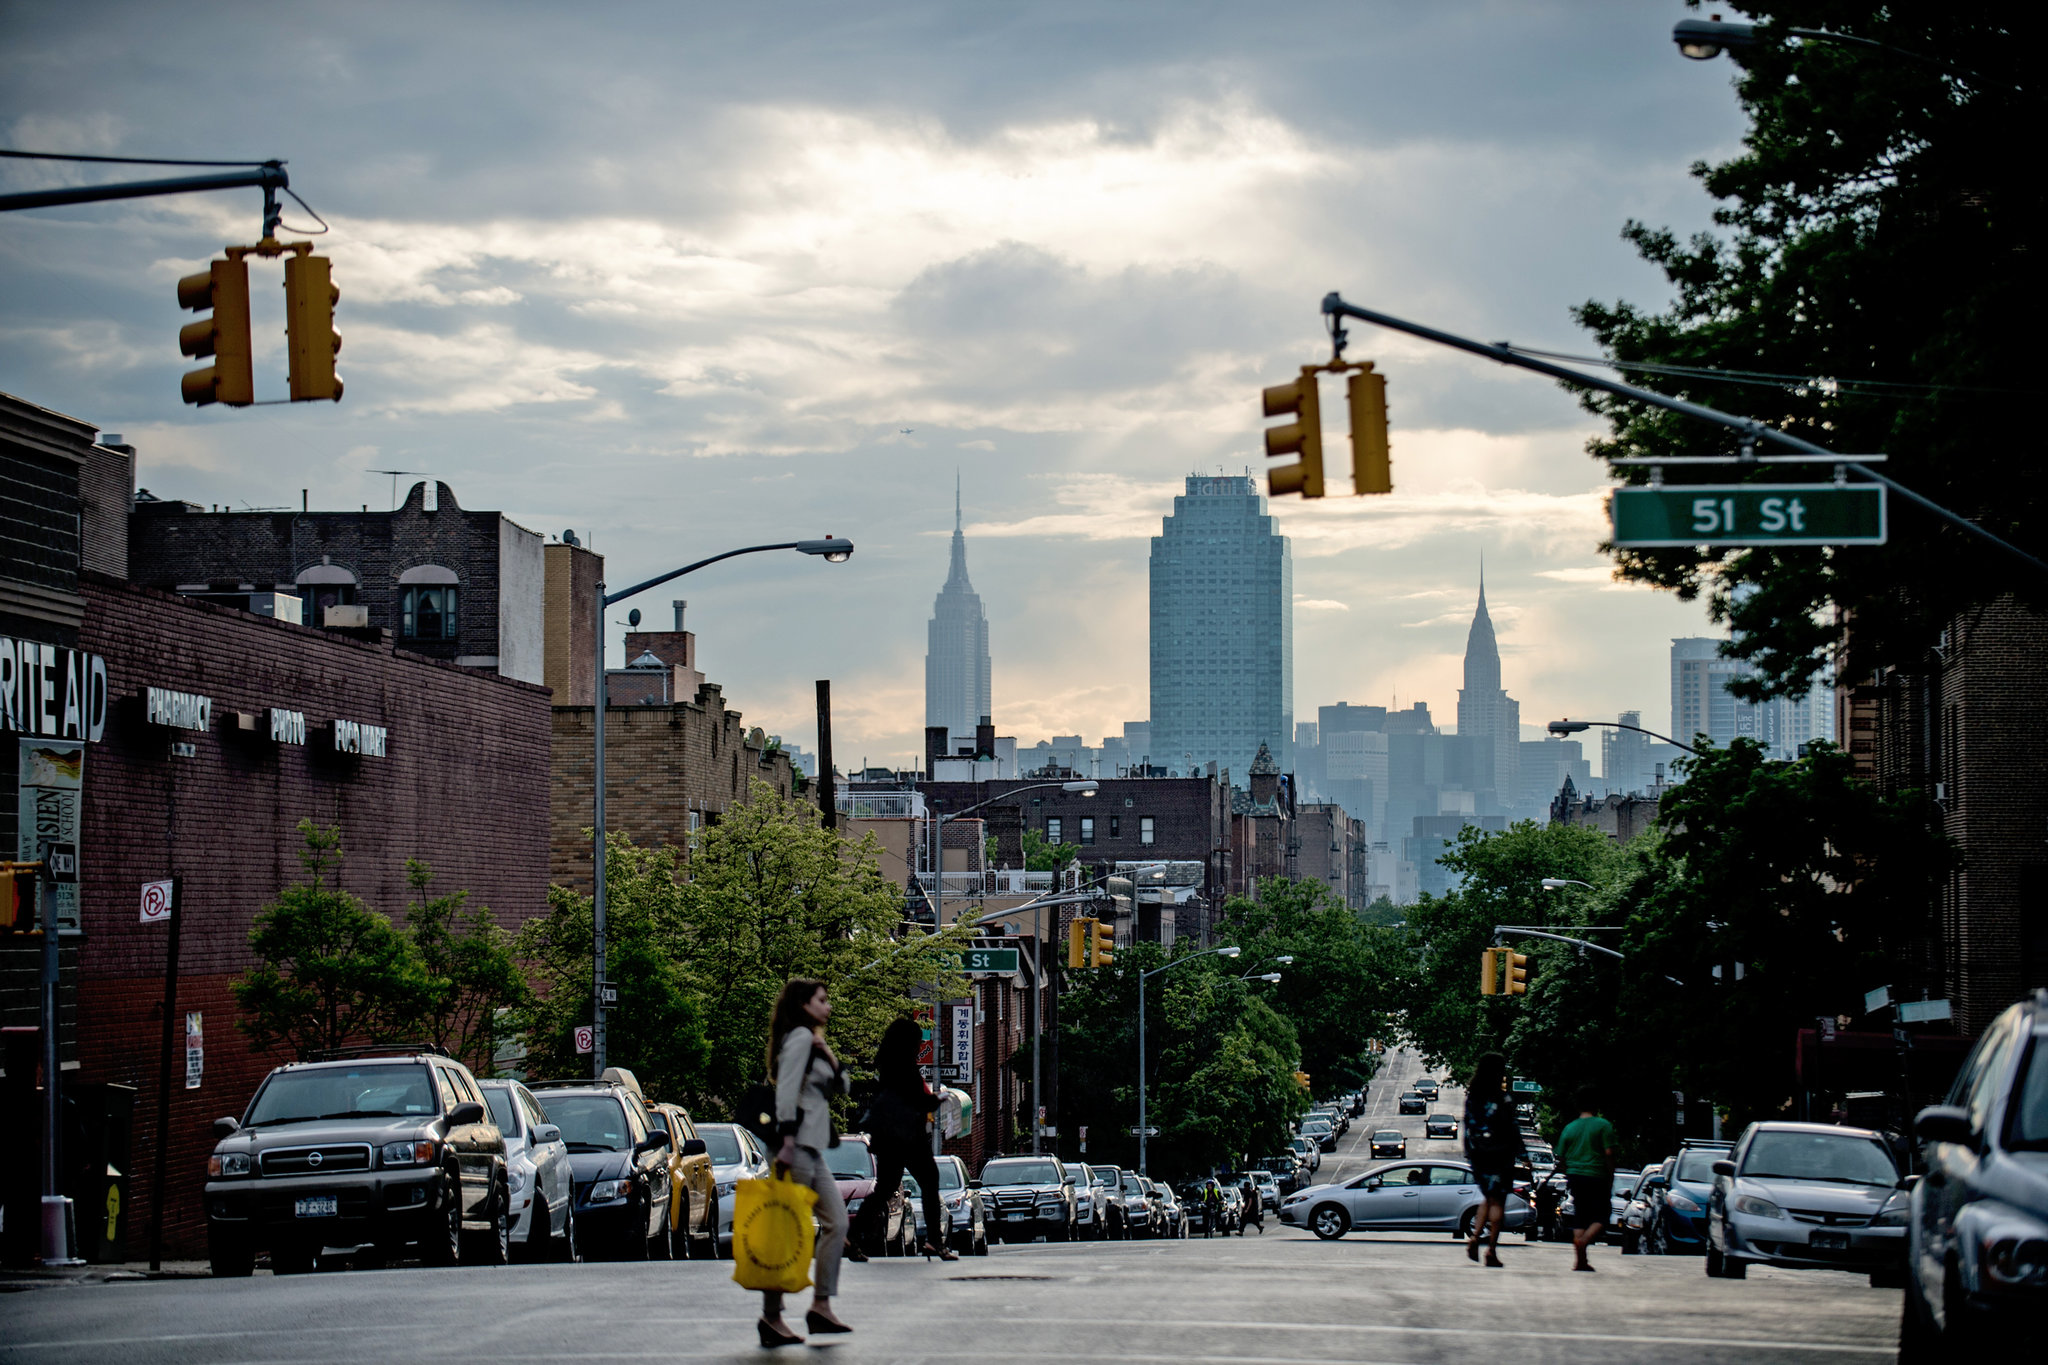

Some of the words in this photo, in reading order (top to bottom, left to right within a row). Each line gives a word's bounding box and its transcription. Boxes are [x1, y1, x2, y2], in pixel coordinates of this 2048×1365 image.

[1202, 480, 1231, 496] citi
[1692, 498, 1735, 532] 51
[1759, 497, 1806, 531] St
[0, 637, 56, 735] RITE
[63, 650, 107, 742] AID
[147, 687, 211, 732] PHARMACY
[270, 708, 305, 745] PHOTO
[335, 719, 360, 753] FOOD
[361, 724, 387, 757] MART
[60, 791, 75, 837] SCHOOL
[971, 953, 990, 968] St
